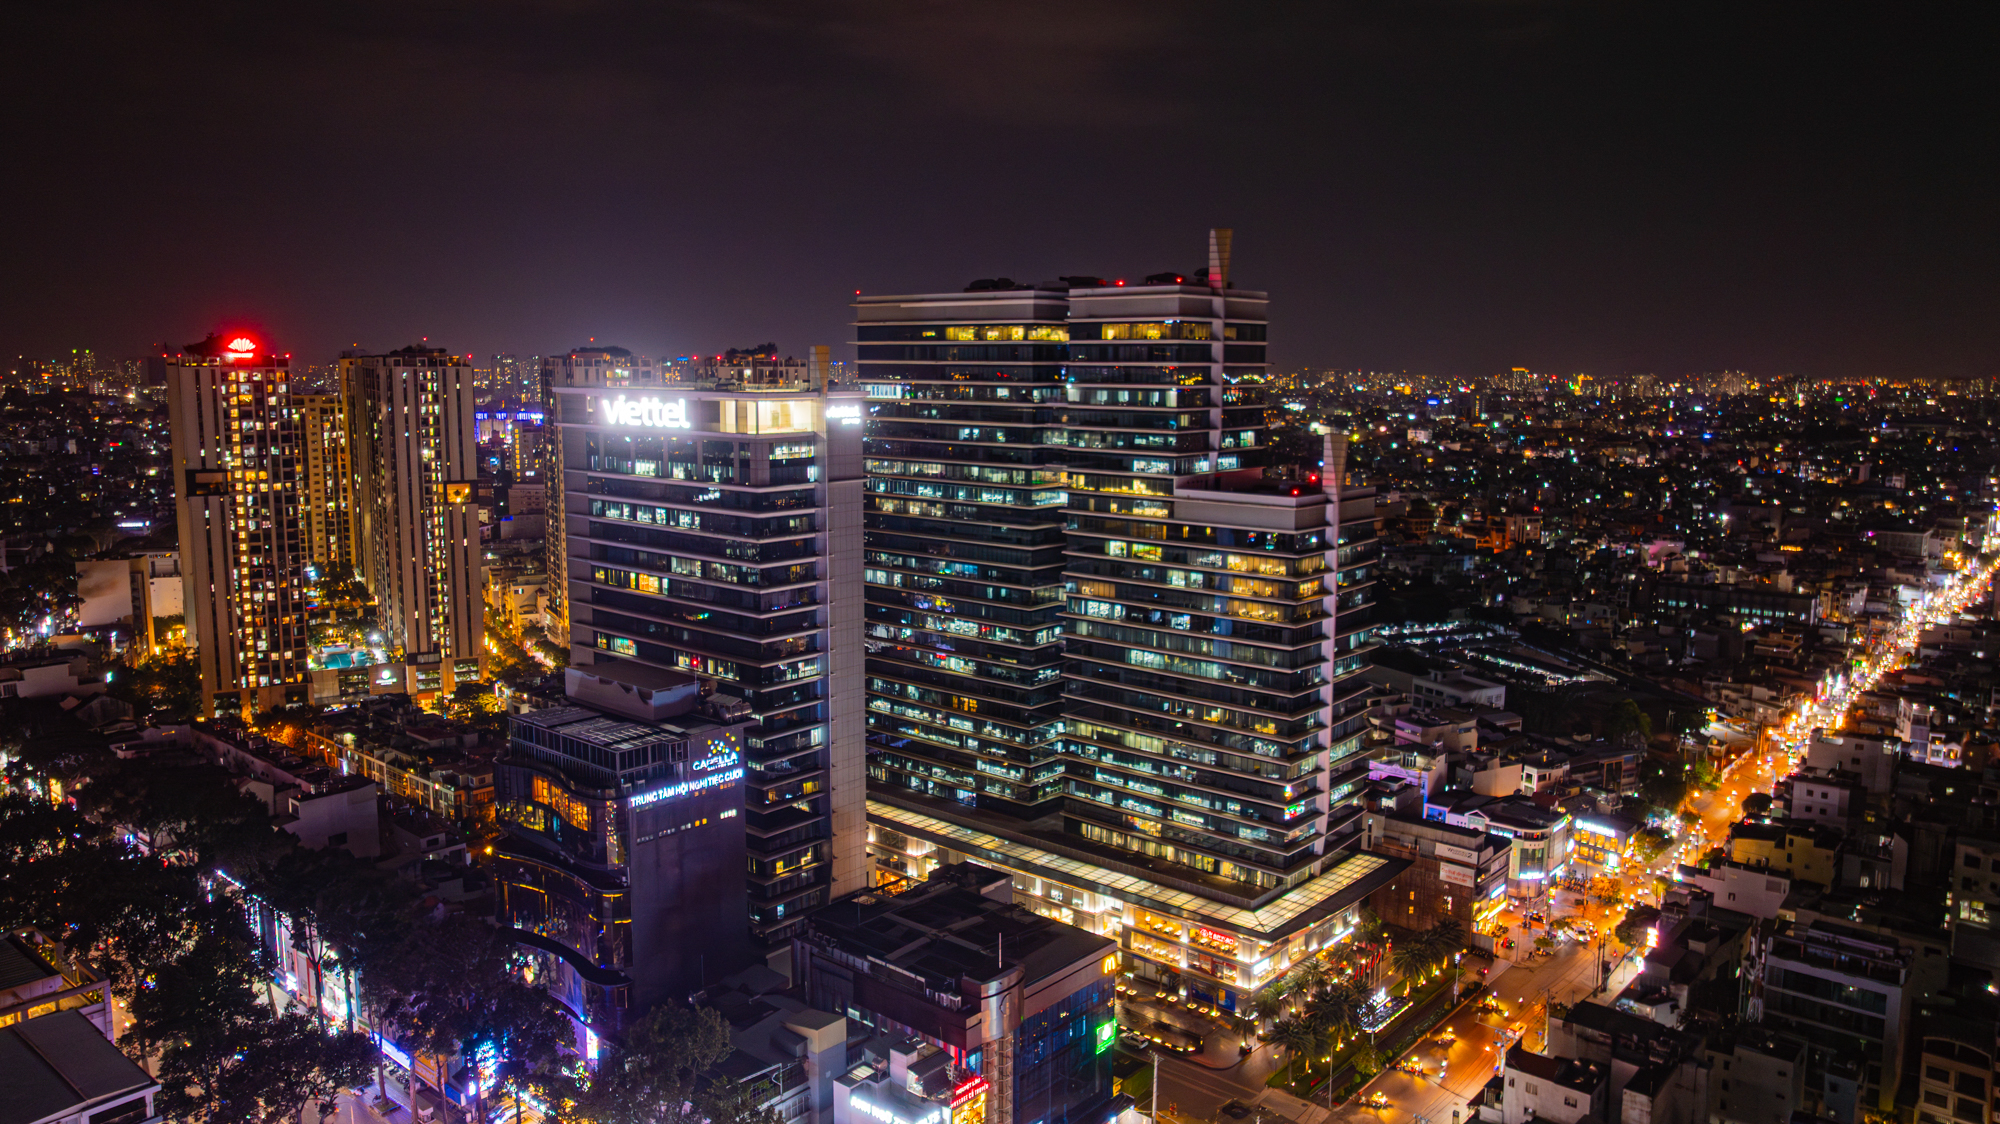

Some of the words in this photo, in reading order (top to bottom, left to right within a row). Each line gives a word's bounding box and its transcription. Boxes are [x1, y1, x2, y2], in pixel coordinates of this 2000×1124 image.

[602, 395, 690, 428] viettel
[693, 752, 738, 770] CAPELLA
[630, 791, 657, 807] TRUNG
